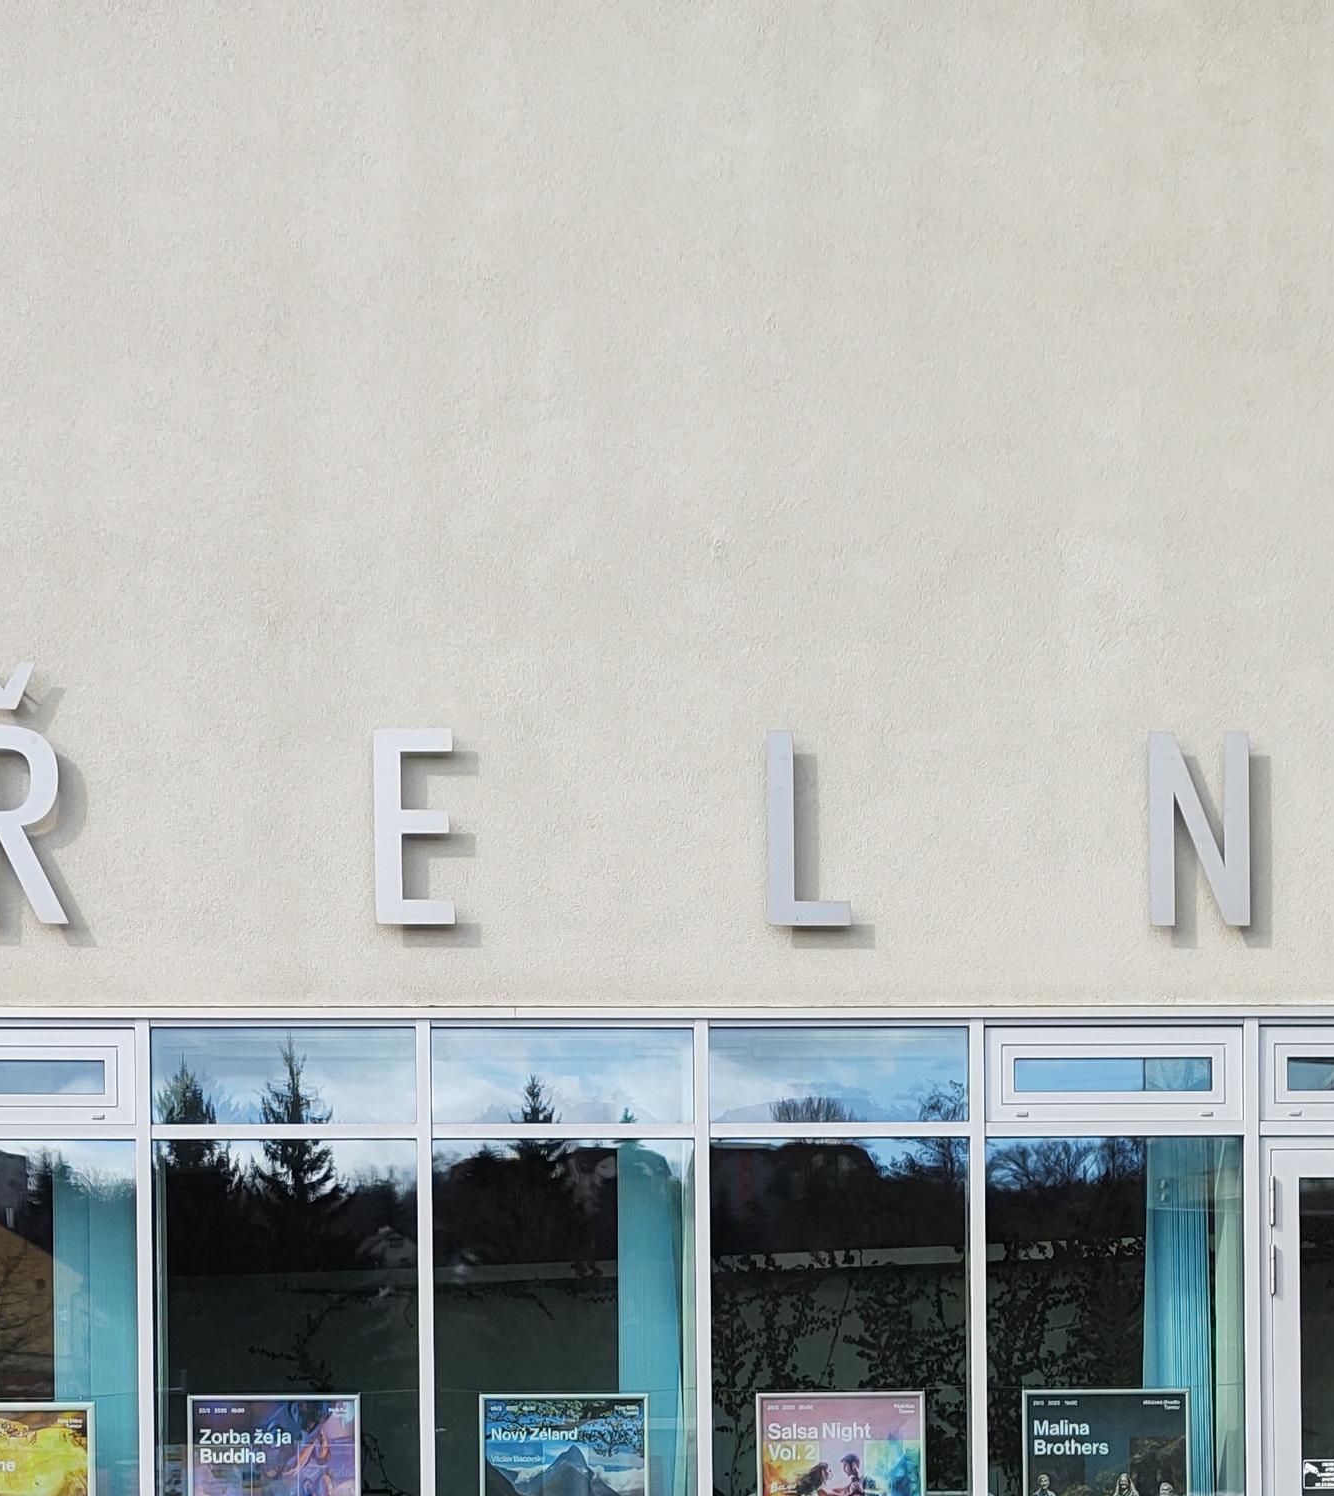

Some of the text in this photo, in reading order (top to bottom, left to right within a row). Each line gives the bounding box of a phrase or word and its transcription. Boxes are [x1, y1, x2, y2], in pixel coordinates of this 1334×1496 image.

[491, 1427, 578, 1443] Nový Zéland
[768, 1422, 872, 1442] Salsa Night
[1033, 1420, 1090, 1436] Malina
[199, 1428, 292, 1447] Zorba že ja
[768, 1443, 816, 1461] Vol. 2
[1033, 1439, 1109, 1455] Brothers
[200, 1448, 266, 1464] Buddha
